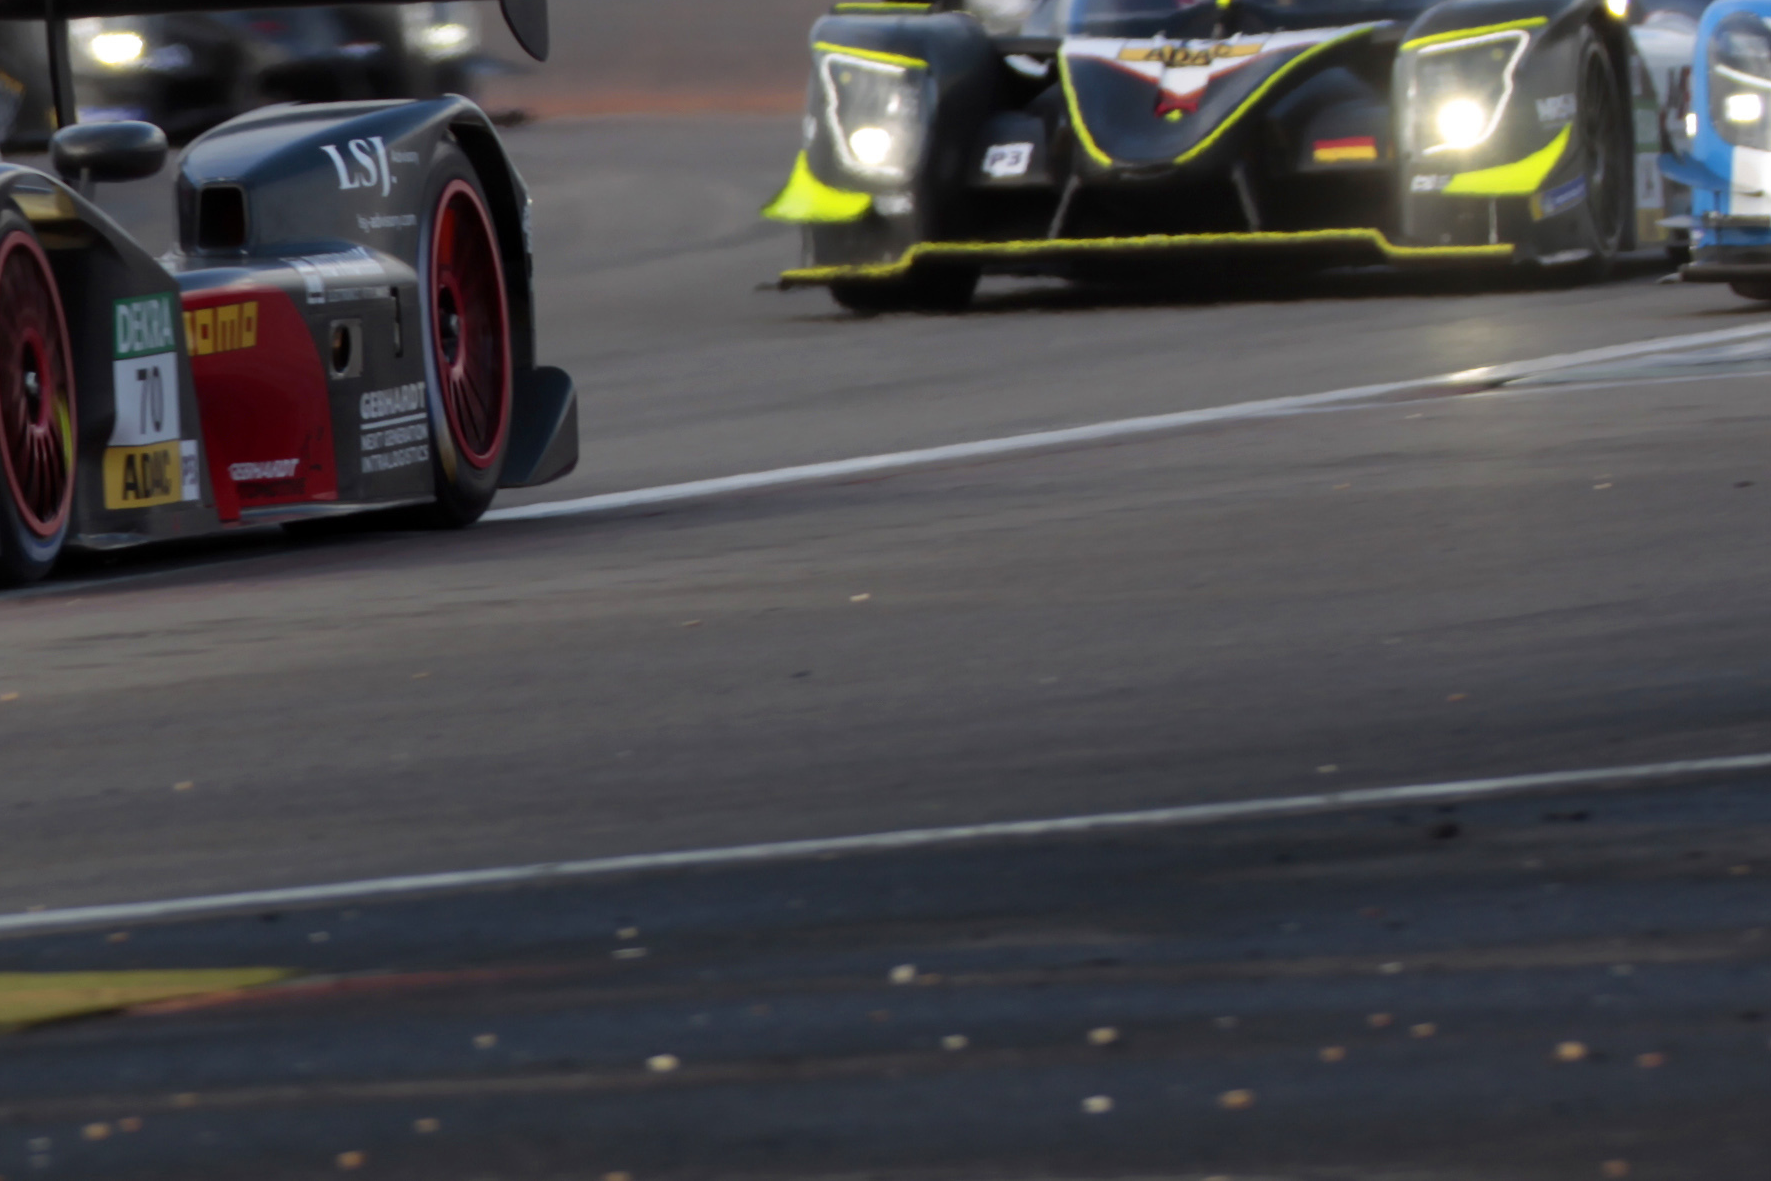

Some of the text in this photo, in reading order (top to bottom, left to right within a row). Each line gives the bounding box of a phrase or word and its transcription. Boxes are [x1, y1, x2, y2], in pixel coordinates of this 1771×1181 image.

[116, 296, 175, 354] DEKRA
[135, 365, 165, 435] 70
[359, 381, 426, 420] GEBHARDT
[122, 449, 171, 501] ADAC
